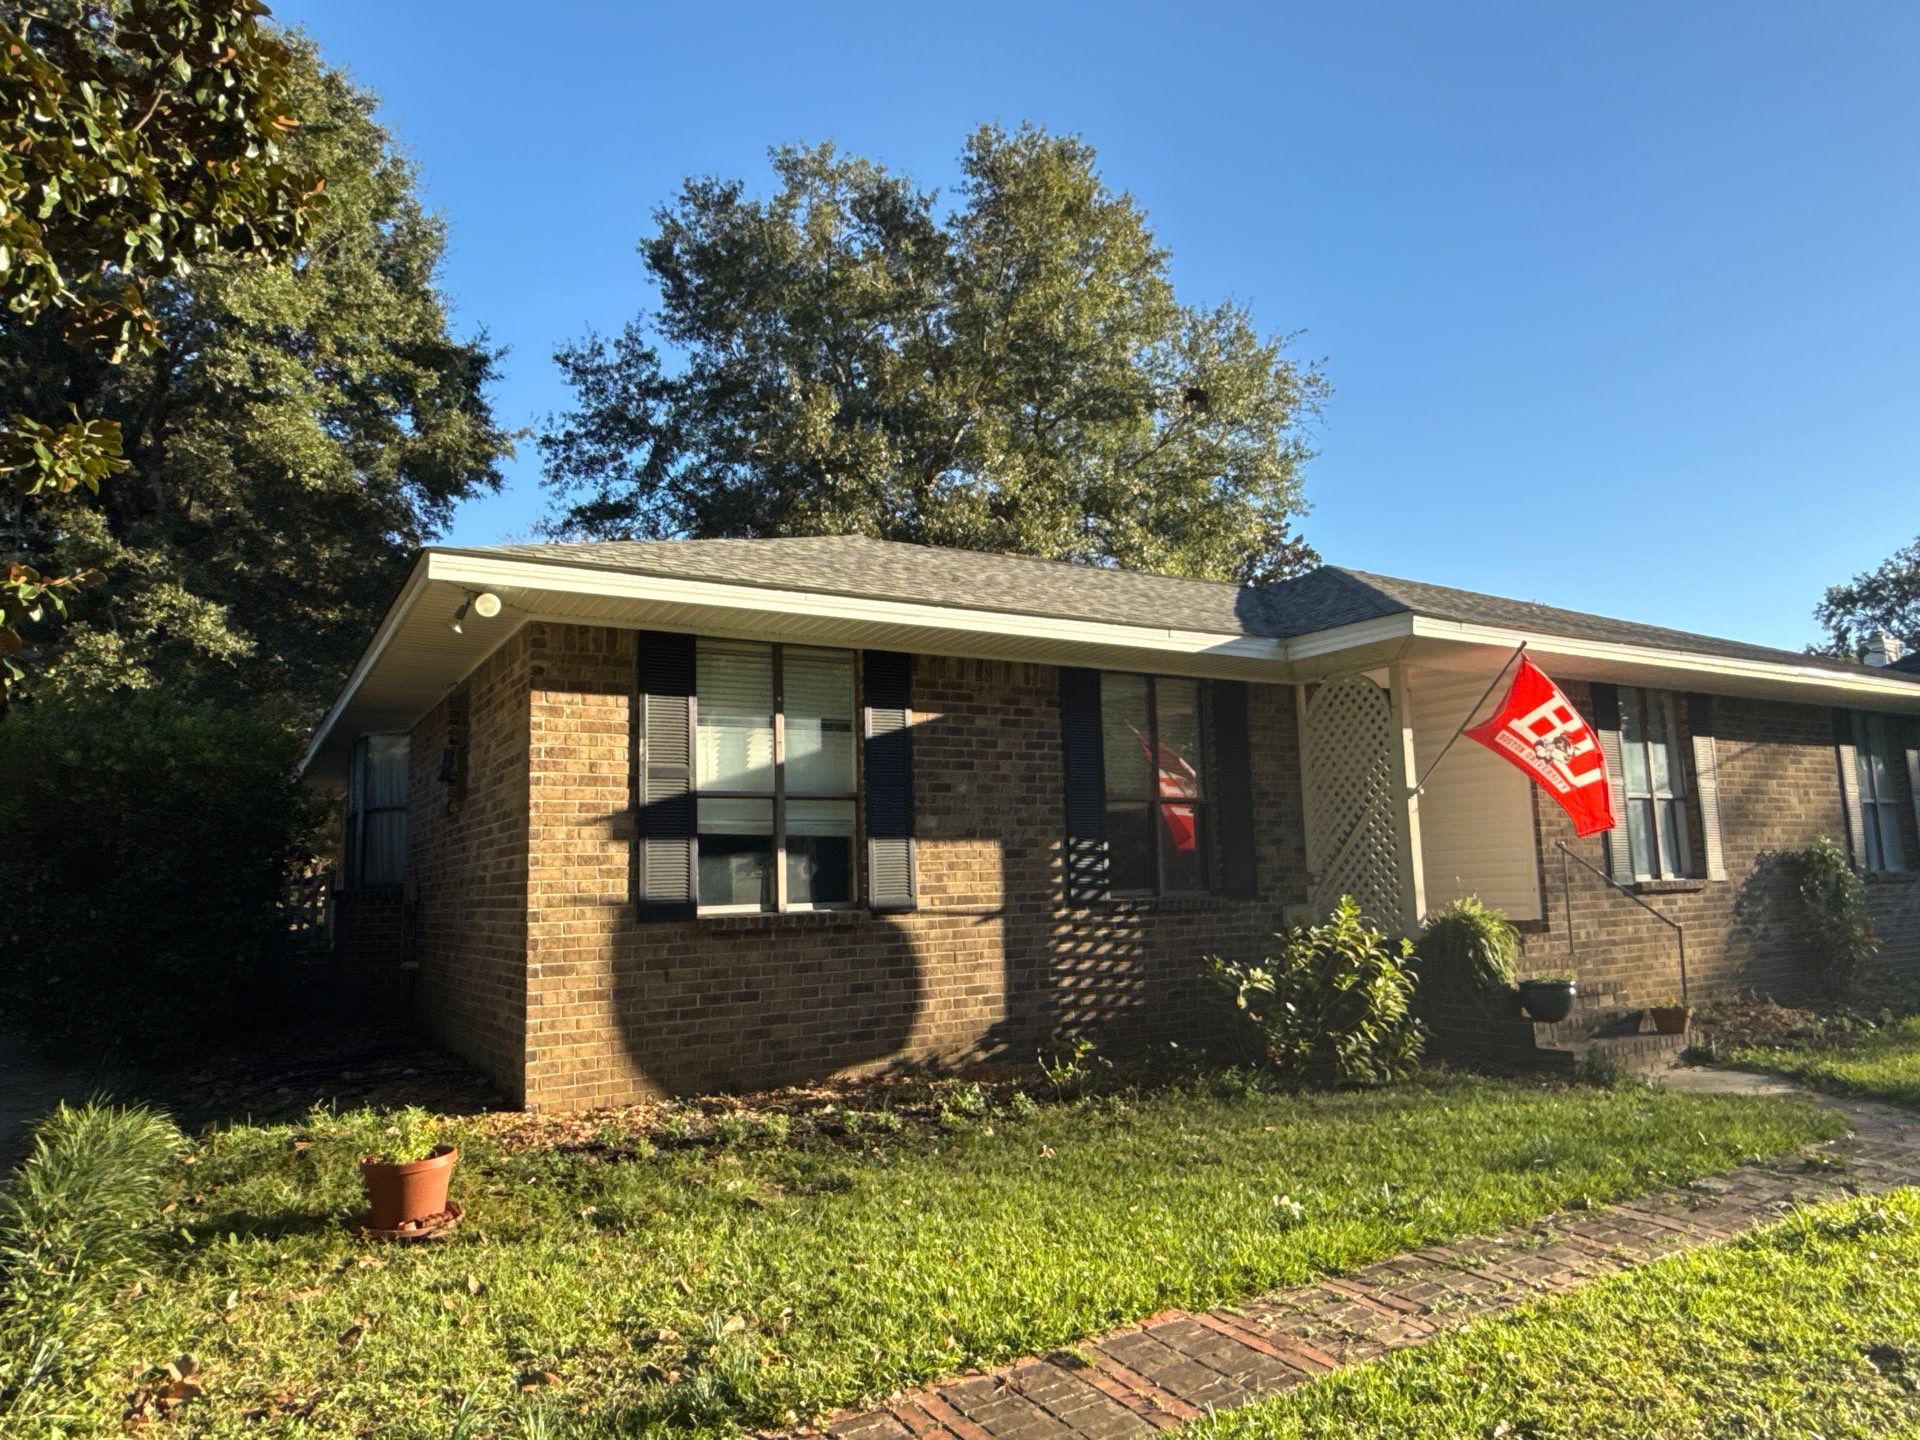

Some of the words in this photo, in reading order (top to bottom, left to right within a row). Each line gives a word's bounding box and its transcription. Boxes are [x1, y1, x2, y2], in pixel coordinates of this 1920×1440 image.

[1498, 733, 1526, 754] BOSTON
[1526, 752, 1568, 790] UNIVERSITY
[1508, 690, 1602, 788] BU
